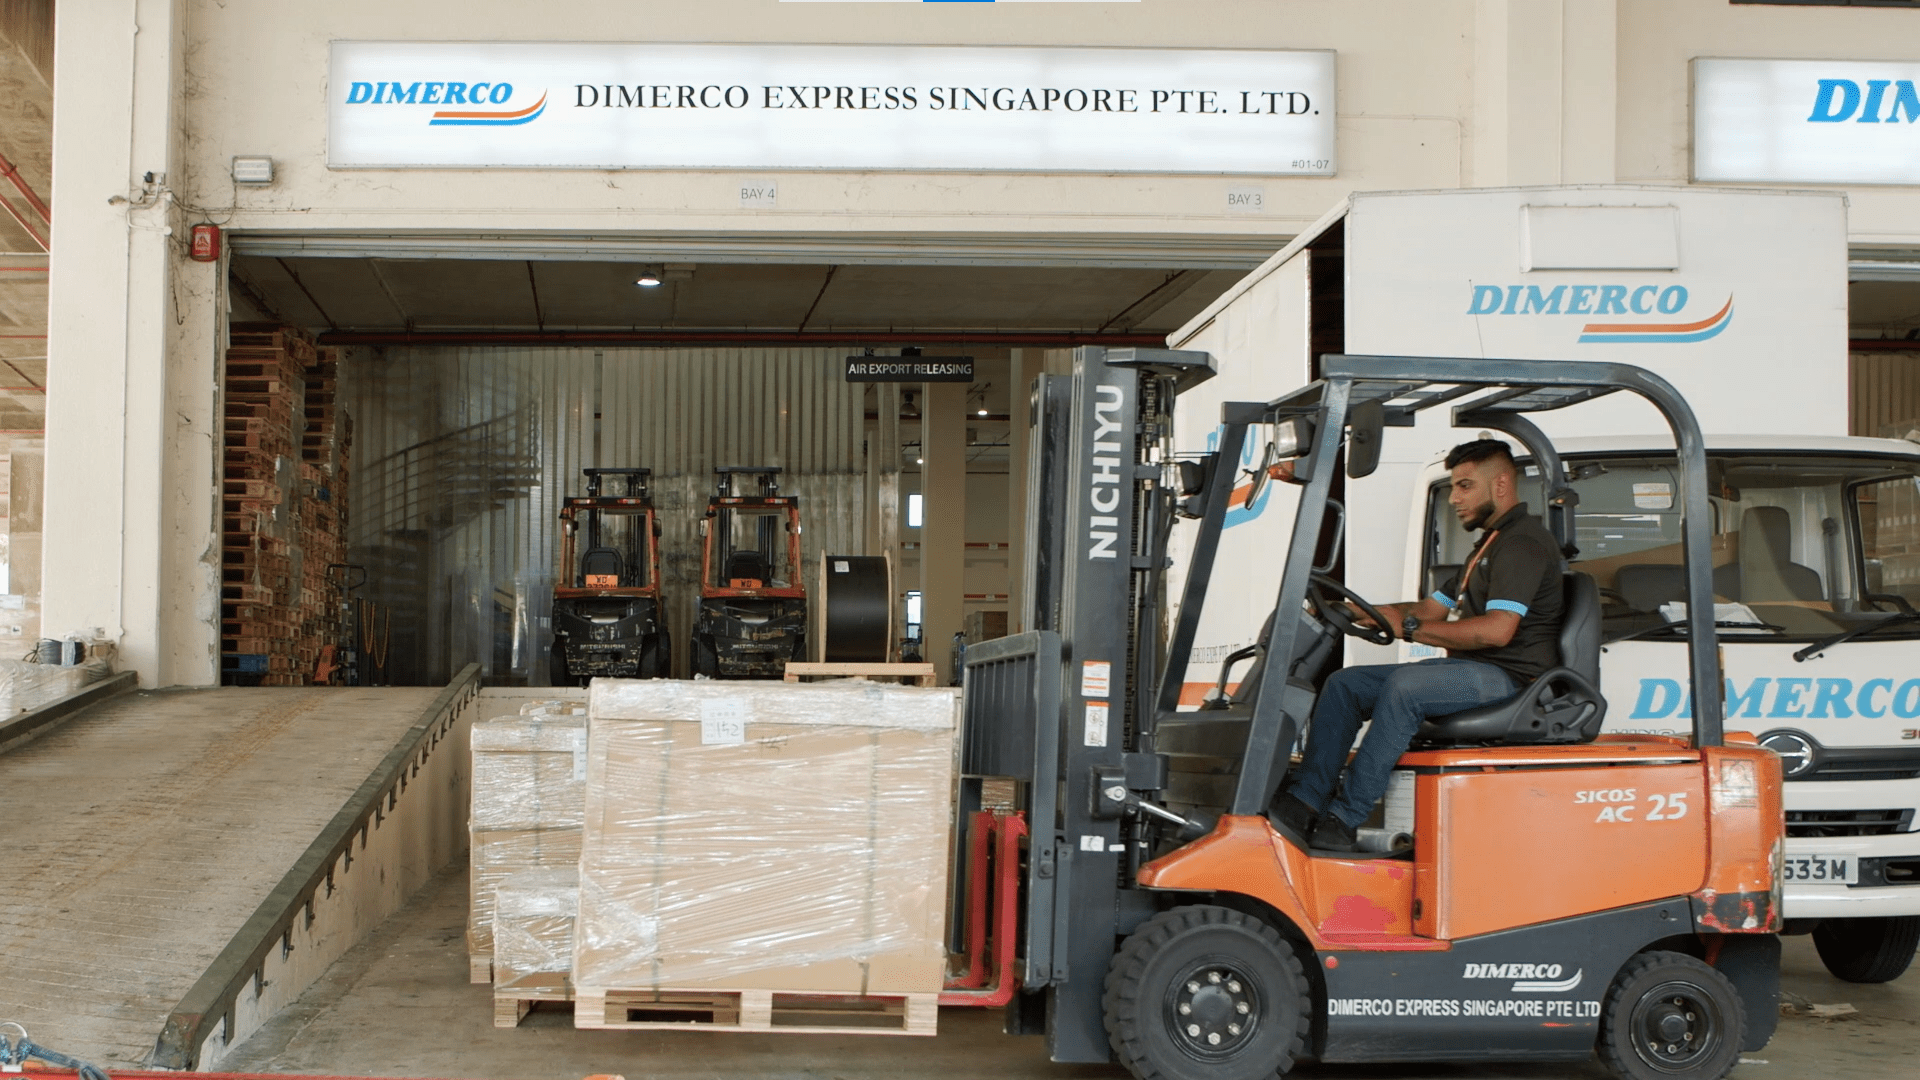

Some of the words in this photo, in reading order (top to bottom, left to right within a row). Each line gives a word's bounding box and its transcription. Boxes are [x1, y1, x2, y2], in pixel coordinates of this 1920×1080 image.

[345, 81, 514, 105] DIMERCO
[574, 84, 749, 109] DIMERCO
[761, 85, 918, 110] EXPRESS
[929, 86, 1138, 112] SINGAPORE
[1150, 89, 1227, 114] PTE.
[1239, 91, 1320, 116] LTD.
[1291, 159, 1330, 170] #01-07
[741, 187, 763, 200] BAY
[767, 187, 775, 200] 4
[1228, 193, 1250, 206] BAY
[1255, 193, 1262, 206] 3
[1466, 284, 1689, 315] DIMERCO
[848, 363, 867, 375] AIR
[868, 363, 911, 375] EXPORT
[913, 363, 972, 375] RELEASING
[1089, 385, 1124, 560] NICHIYU
[1573, 788, 1637, 804] SICOS
[1596, 805, 1636, 823] AC
[1645, 792, 1688, 821] 25
[1463, 963, 1562, 979] DIMERCO
[1328, 998, 1392, 1016] DIMERCO
[1395, 999, 1460, 1017] EXPRESS
[1462, 999, 1543, 1017] SINGAPORE
[1546, 1000, 1573, 1017] PTE
[1575, 1000, 1601, 1018] LTD
